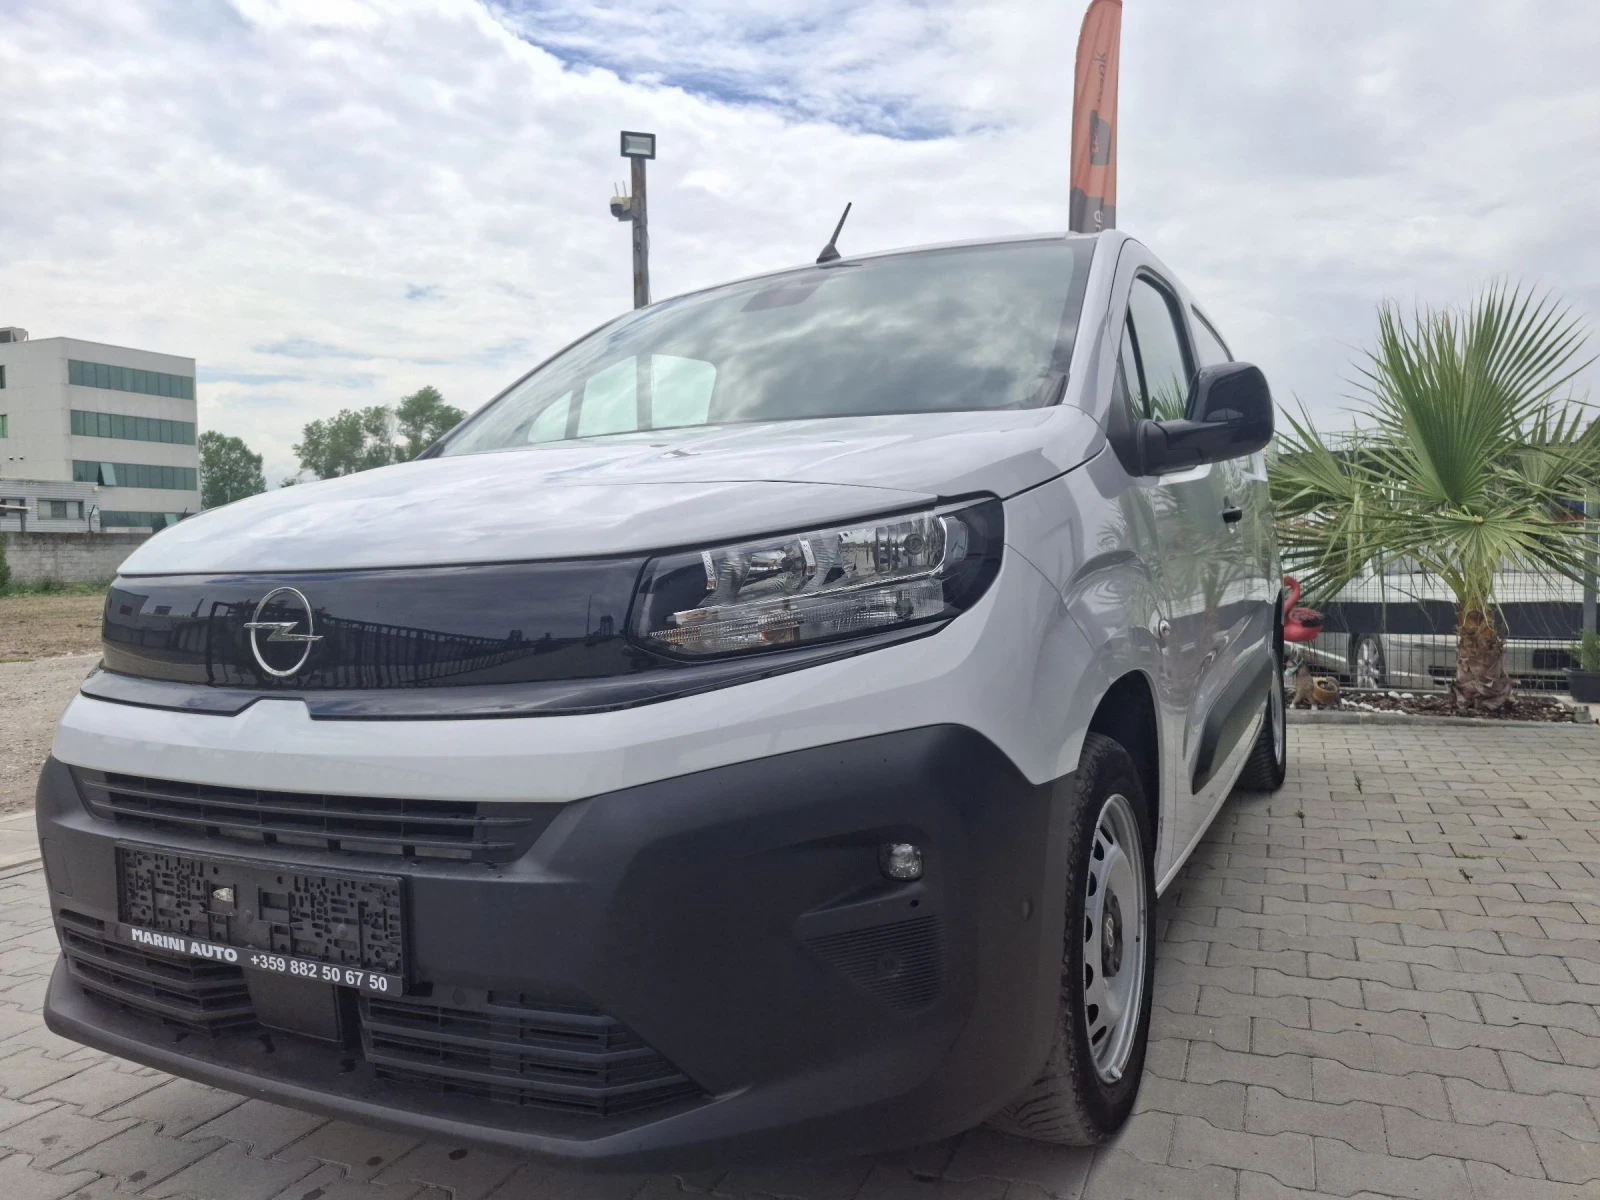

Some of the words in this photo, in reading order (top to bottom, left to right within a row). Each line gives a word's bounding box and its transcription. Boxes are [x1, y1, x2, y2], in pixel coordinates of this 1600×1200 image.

[131, 928, 185, 951] MARINI
[190, 942, 238, 962] AUTO
[250, 955, 286, 972] +359
[290, 961, 317, 978] 882
[322, 966, 341, 983] 50
[346, 970, 364, 986] 67
[369, 974, 387, 992] 50
